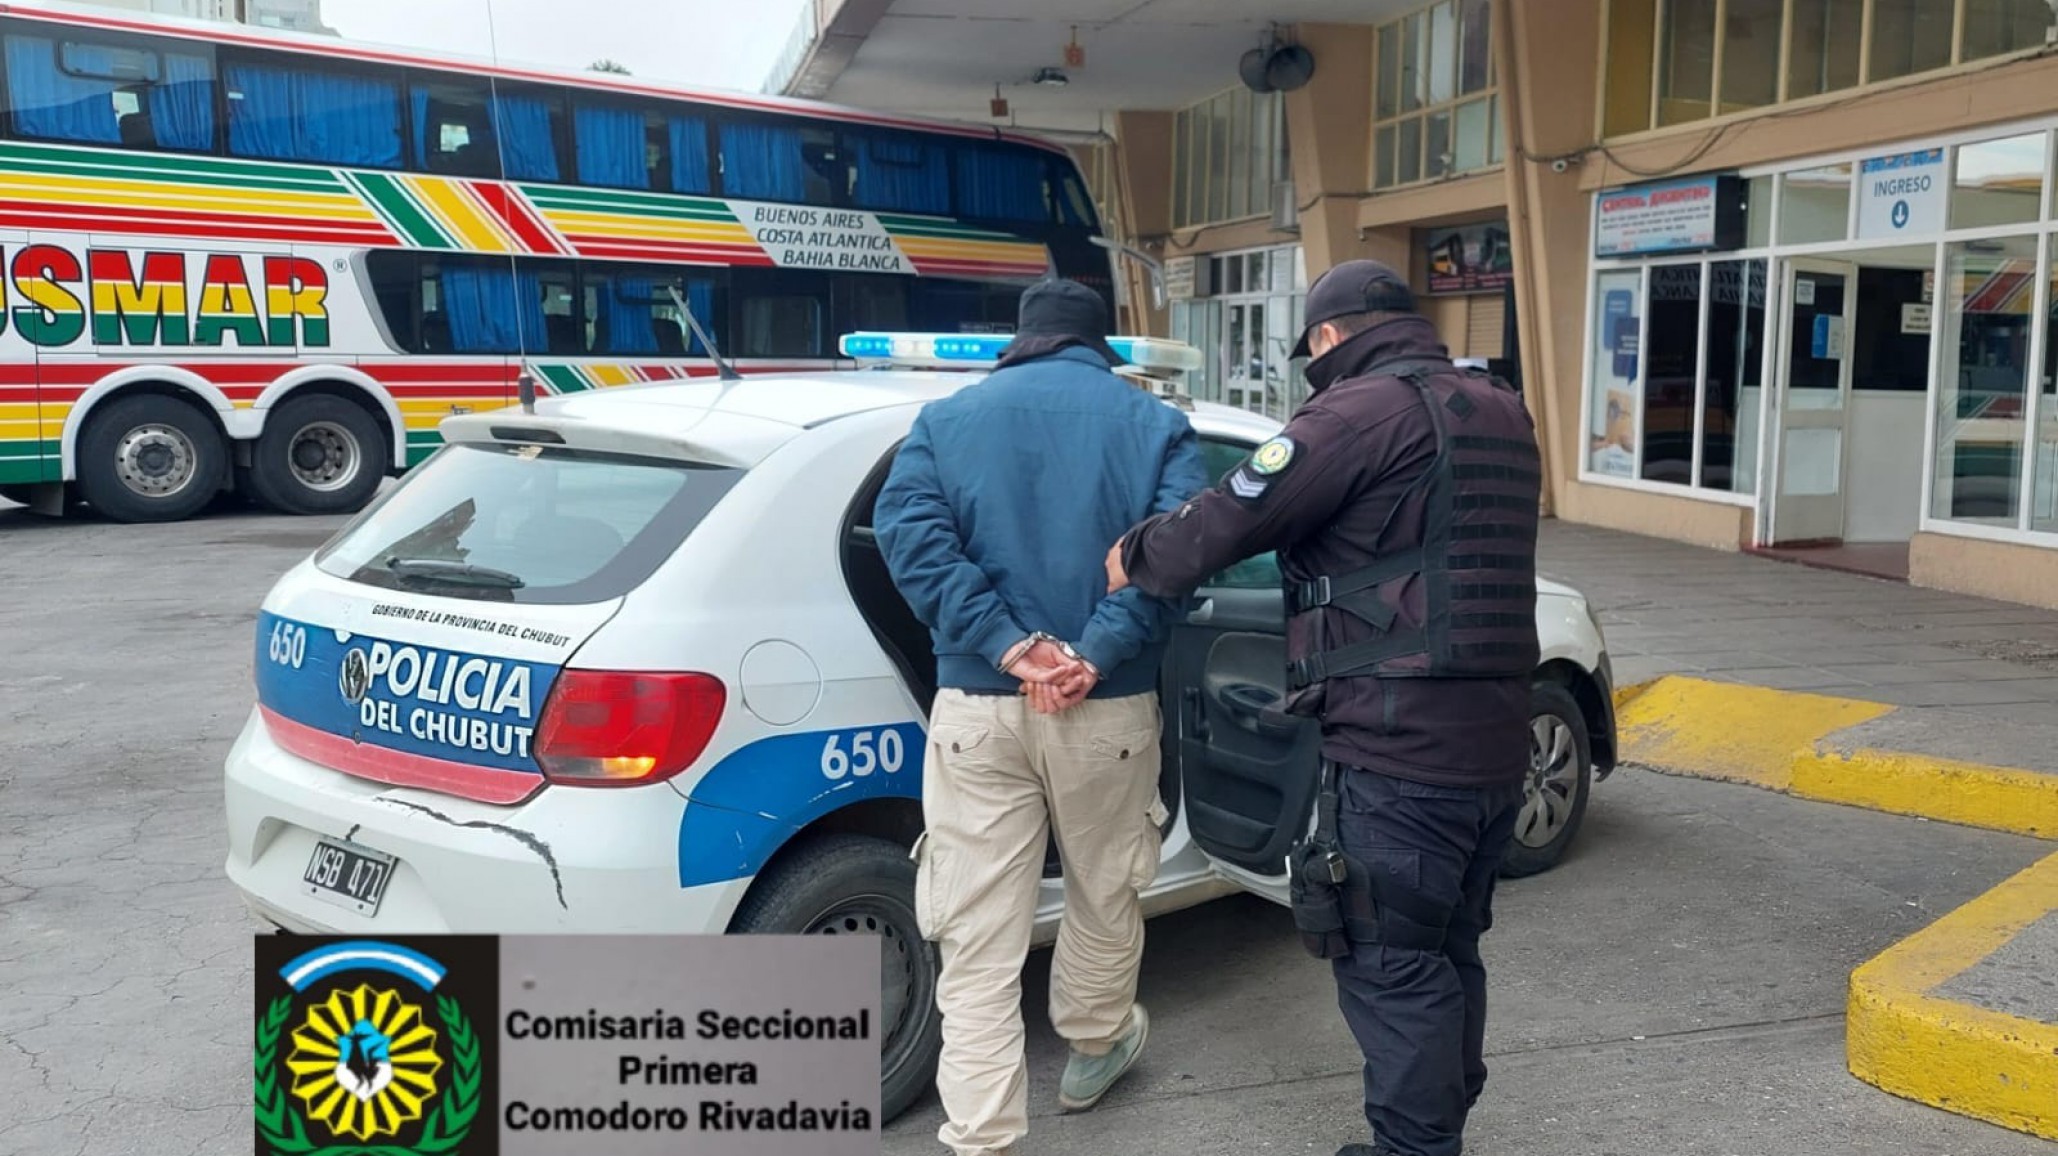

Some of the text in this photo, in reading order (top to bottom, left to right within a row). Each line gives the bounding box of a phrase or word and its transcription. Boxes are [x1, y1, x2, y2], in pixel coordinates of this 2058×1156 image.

[1874, 175, 1931, 197] INGRESO
[754, 207, 864, 229] BUENOS AIRES
[757, 228, 891, 251] COSTA ATLANTICA
[783, 250, 900, 270] BAHIA BLANCA
[0, 244, 330, 347] SMAR
[269, 620, 306, 669] 650
[371, 604, 572, 648] GOBIERNO DE LA PROVINCIA DEL CHUBUT
[367, 641, 532, 719] POLICIA
[360, 697, 534, 758] DEL CHUBUT
[821, 728, 904, 780] 650
[305, 844, 383, 902] NSB 471
